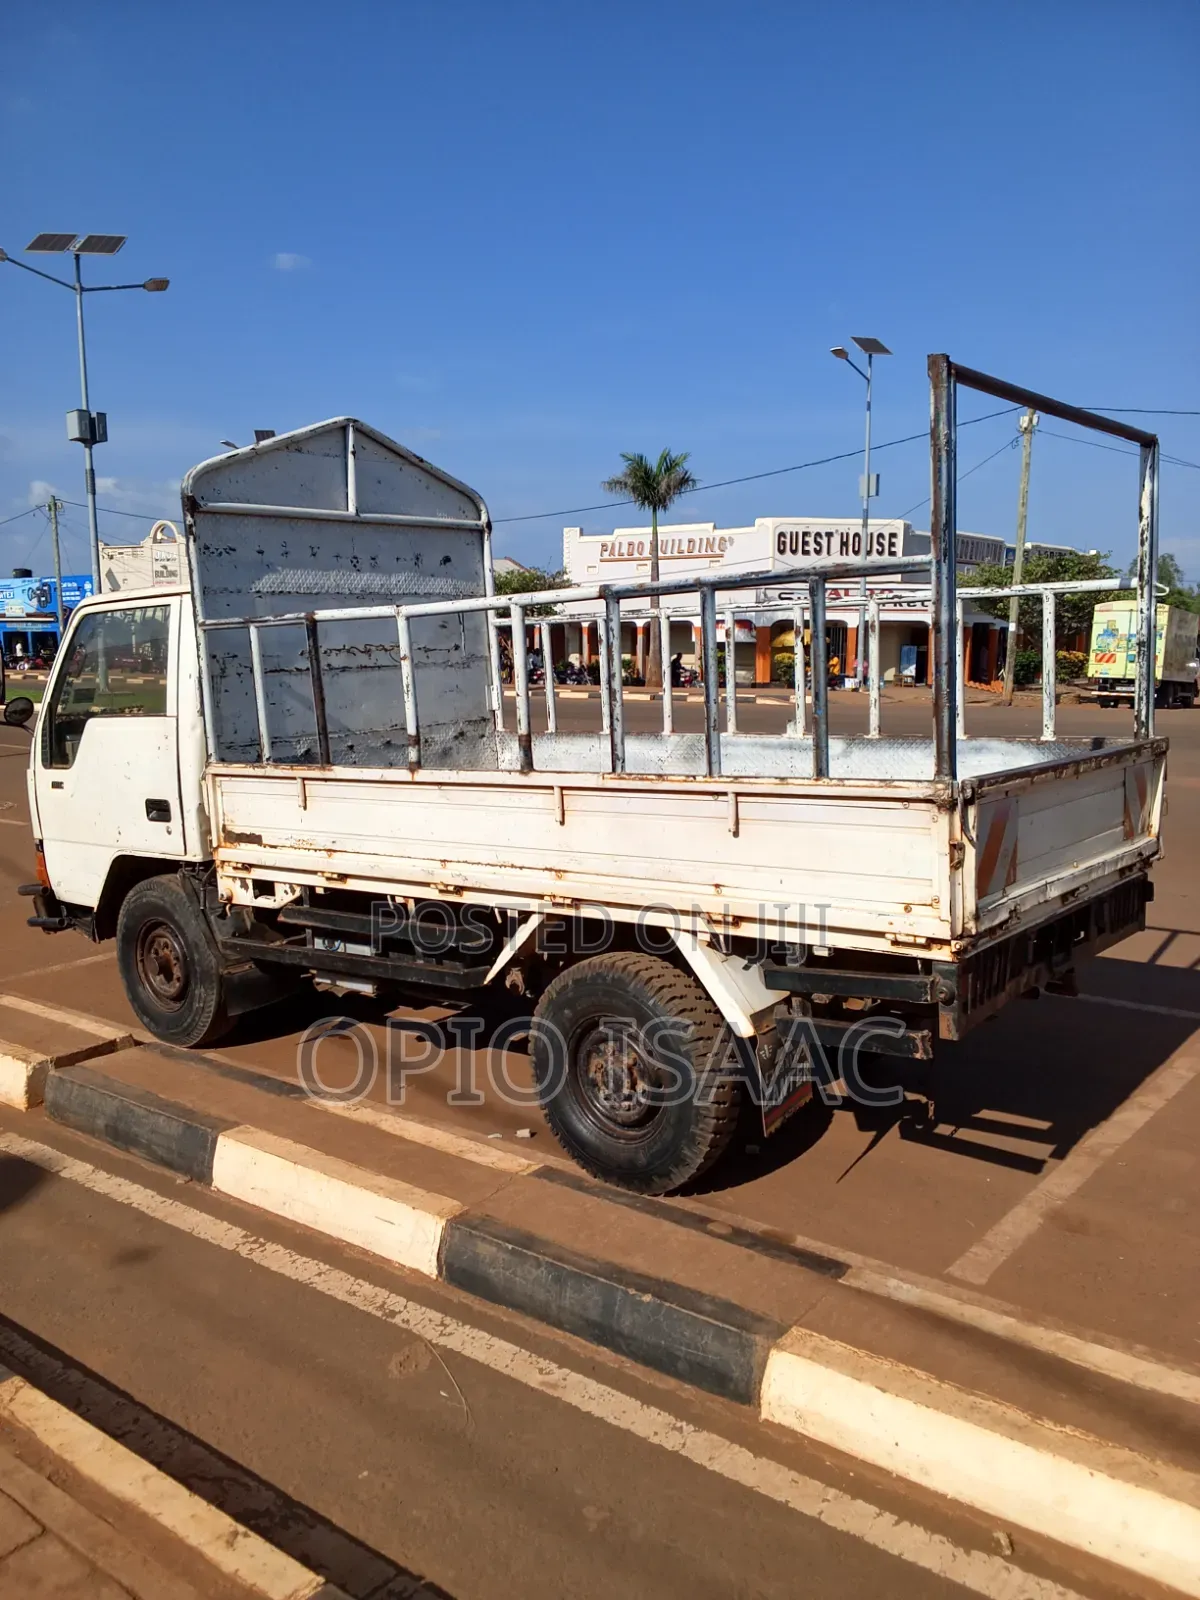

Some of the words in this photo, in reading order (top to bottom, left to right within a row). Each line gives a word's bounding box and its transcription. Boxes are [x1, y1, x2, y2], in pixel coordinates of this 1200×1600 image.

[600, 541, 645, 557] PALDO
[777, 531, 834, 556] GUEST
[839, 531, 898, 557] HOUSE
